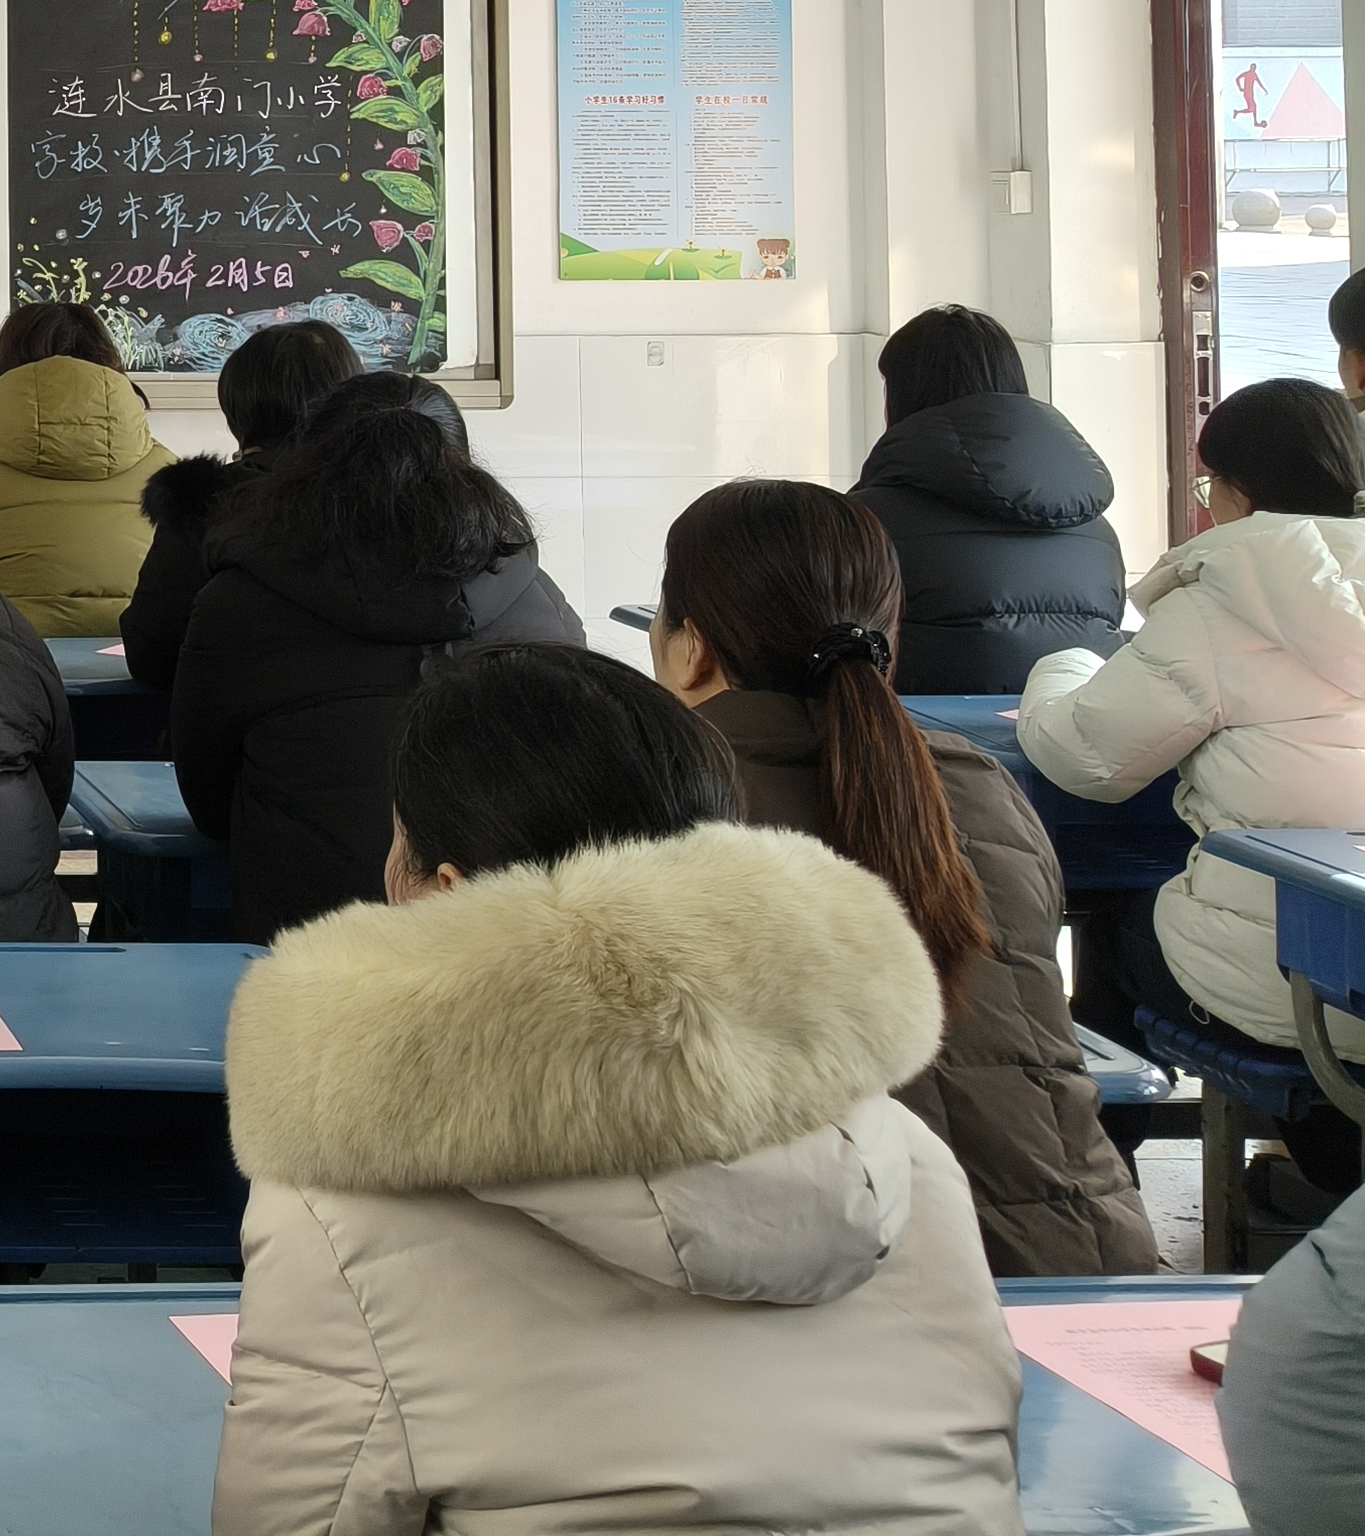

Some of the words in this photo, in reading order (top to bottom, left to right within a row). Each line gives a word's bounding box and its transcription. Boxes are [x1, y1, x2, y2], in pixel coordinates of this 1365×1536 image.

[48, 72, 343, 119] 涟水县南门小学
